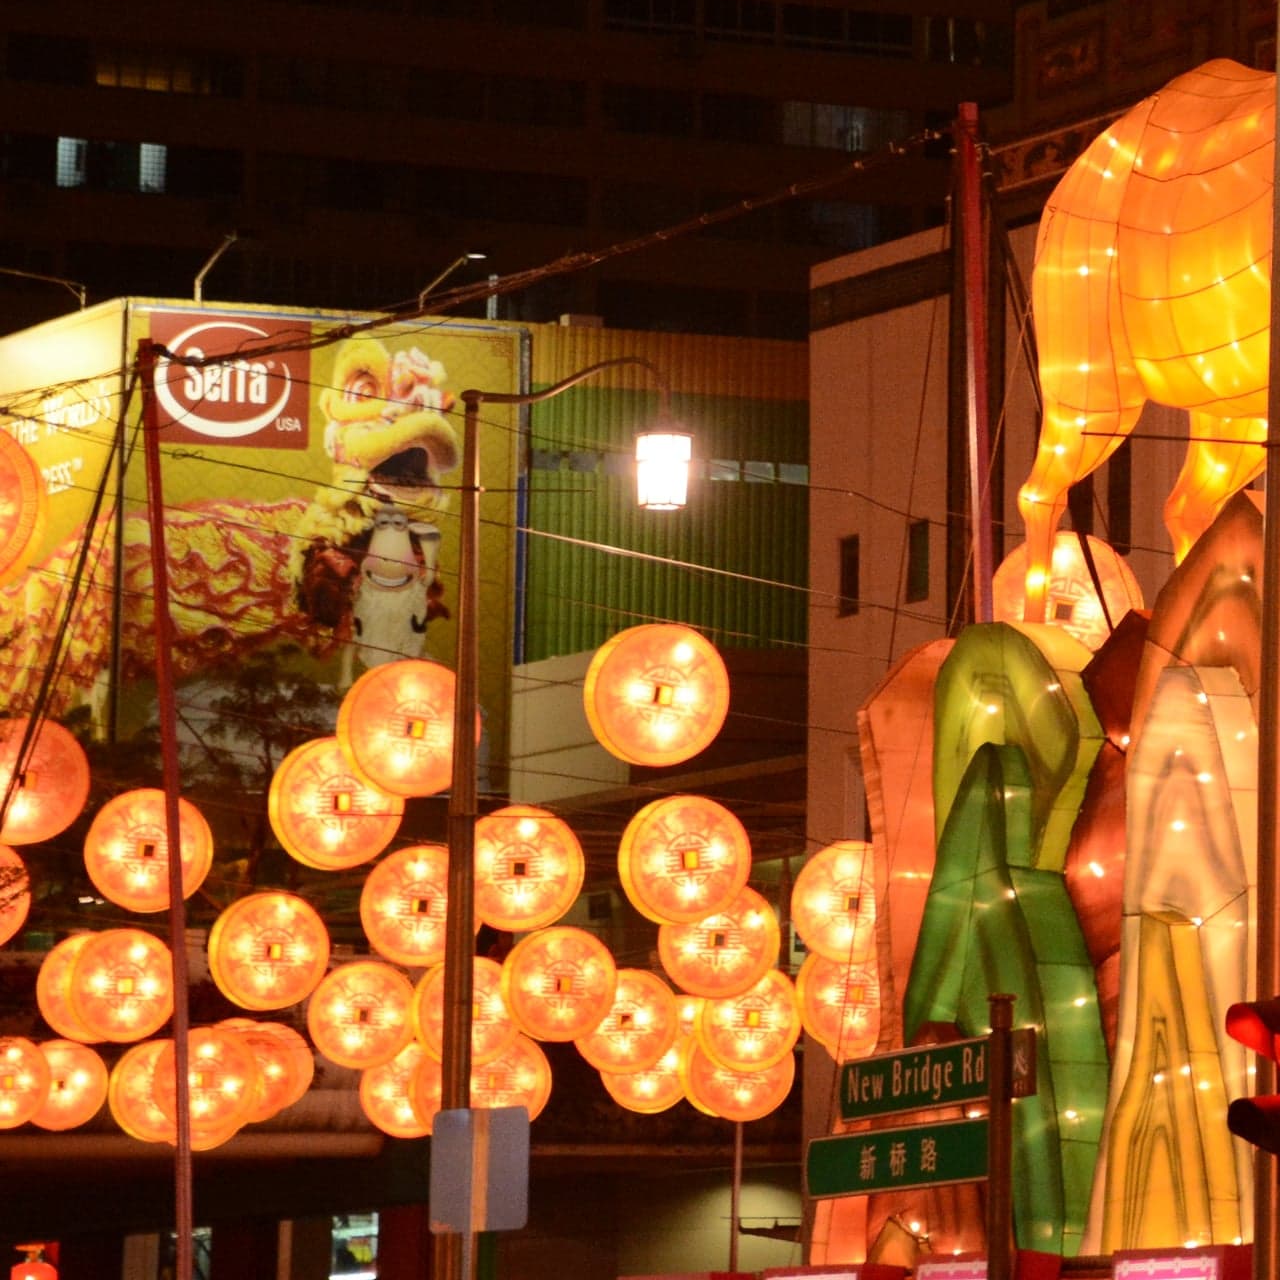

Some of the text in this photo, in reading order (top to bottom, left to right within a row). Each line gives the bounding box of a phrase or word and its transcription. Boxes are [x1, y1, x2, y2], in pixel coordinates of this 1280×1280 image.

[275, 417, 302, 432] USA
[847, 1065, 884, 1104] New
[892, 1054, 953, 1100] Bridge
[962, 1045, 985, 1085] Rd
[859, 1137, 937, 1181] 新桥路
